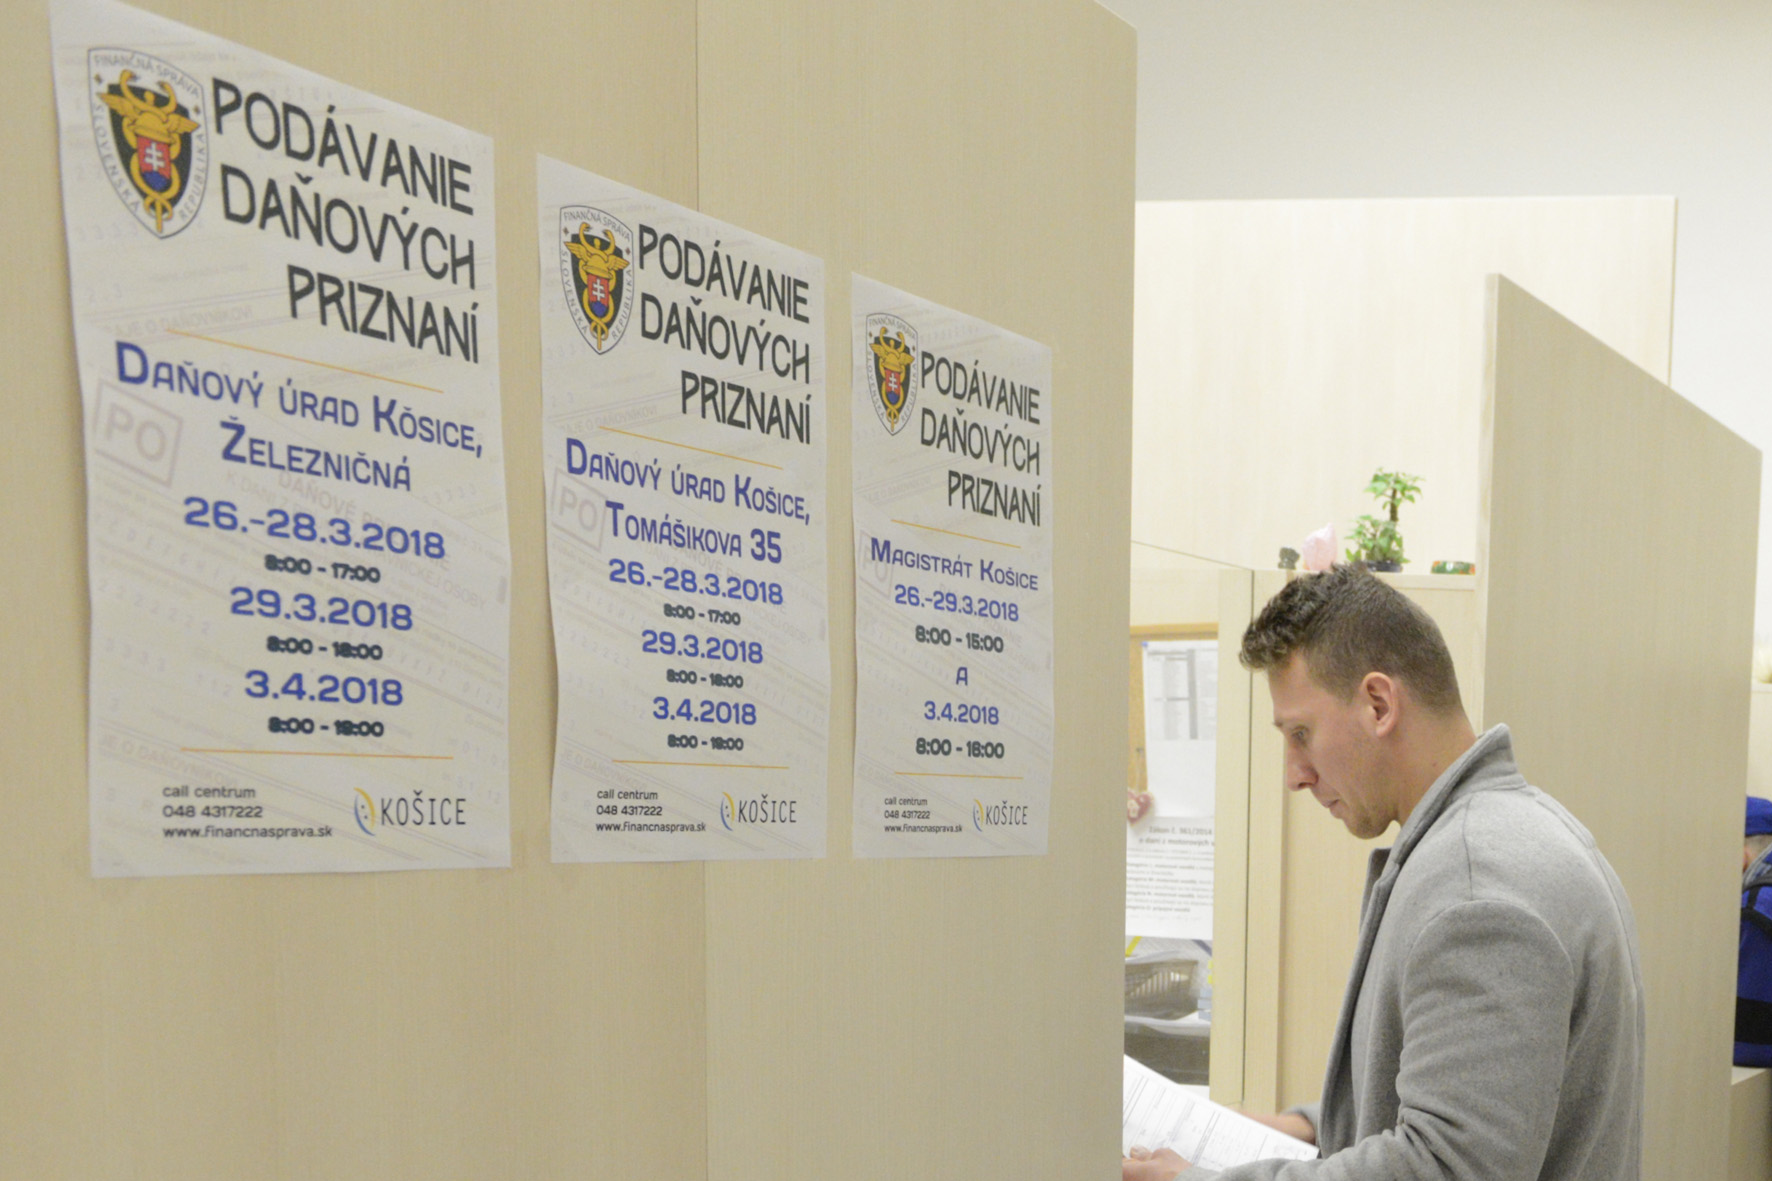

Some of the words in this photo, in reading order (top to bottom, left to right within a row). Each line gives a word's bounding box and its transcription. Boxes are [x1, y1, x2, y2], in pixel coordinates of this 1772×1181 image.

[213, 77, 474, 216] PODÁVANIE
[220, 163, 475, 290] DAŇOVÝCH
[639, 223, 809, 324] PODÁVANIE
[287, 264, 479, 364] PRIZNANÍ
[641, 292, 809, 384] DAŇOVÝCH
[921, 351, 1040, 424] PODÁVANIE
[681, 369, 811, 444] PRIZNANÍ
[921, 407, 1040, 476] DAŇOVÝCH
[948, 470, 1041, 527] PRIZNANÍ
[184, 496, 446, 560] 26.-28.3.2018
[750, 528, 782, 564] 35
[264, 554, 312, 576] 8:00
[331, 561, 381, 583] 17:00
[608, 558, 783, 606] 26.-28.3.2018
[230, 587, 413, 631] 29.3.2018
[663, 604, 695, 620] 8:00
[707, 609, 741, 626] 17:00
[895, 584, 1019, 622] 26.-29.3.2018
[266, 635, 313, 655] 8:00
[641, 629, 763, 664] 29.3.2018
[915, 625, 951, 646] 8:00
[966, 632, 1004, 653] 15:00
[244, 670, 404, 706] 3.4.2018
[956, 666, 968, 686] A
[268, 716, 314, 734] 8:00
[652, 696, 757, 726] 3.4.2018
[924, 700, 999, 725] 3.4.2018
[915, 737, 952, 756] 8:00
[966, 740, 1005, 759] 18:00
[162, 785, 188, 798] call
[194, 786, 256, 799] centrum
[597, 789, 614, 799] call
[617, 789, 658, 800] centrum
[884, 797, 897, 806] call
[899, 797, 928, 806] centrum
[162, 804, 196, 818] 048
[201, 804, 263, 819] 4317222
[380, 790, 467, 826] KOŠICE
[596, 805, 617, 815] 048
[621, 806, 663, 816] 4317222
[738, 793, 797, 823] KOŠICE
[884, 810, 899, 819] 048
[901, 810, 930, 819] 4317222
[986, 800, 1028, 826] KOŠICE
[162, 823, 333, 840] www.financnasprava.sk
[596, 822, 706, 834] www.financnasprava.sk
[884, 824, 963, 834] www.financnasprava.sk
